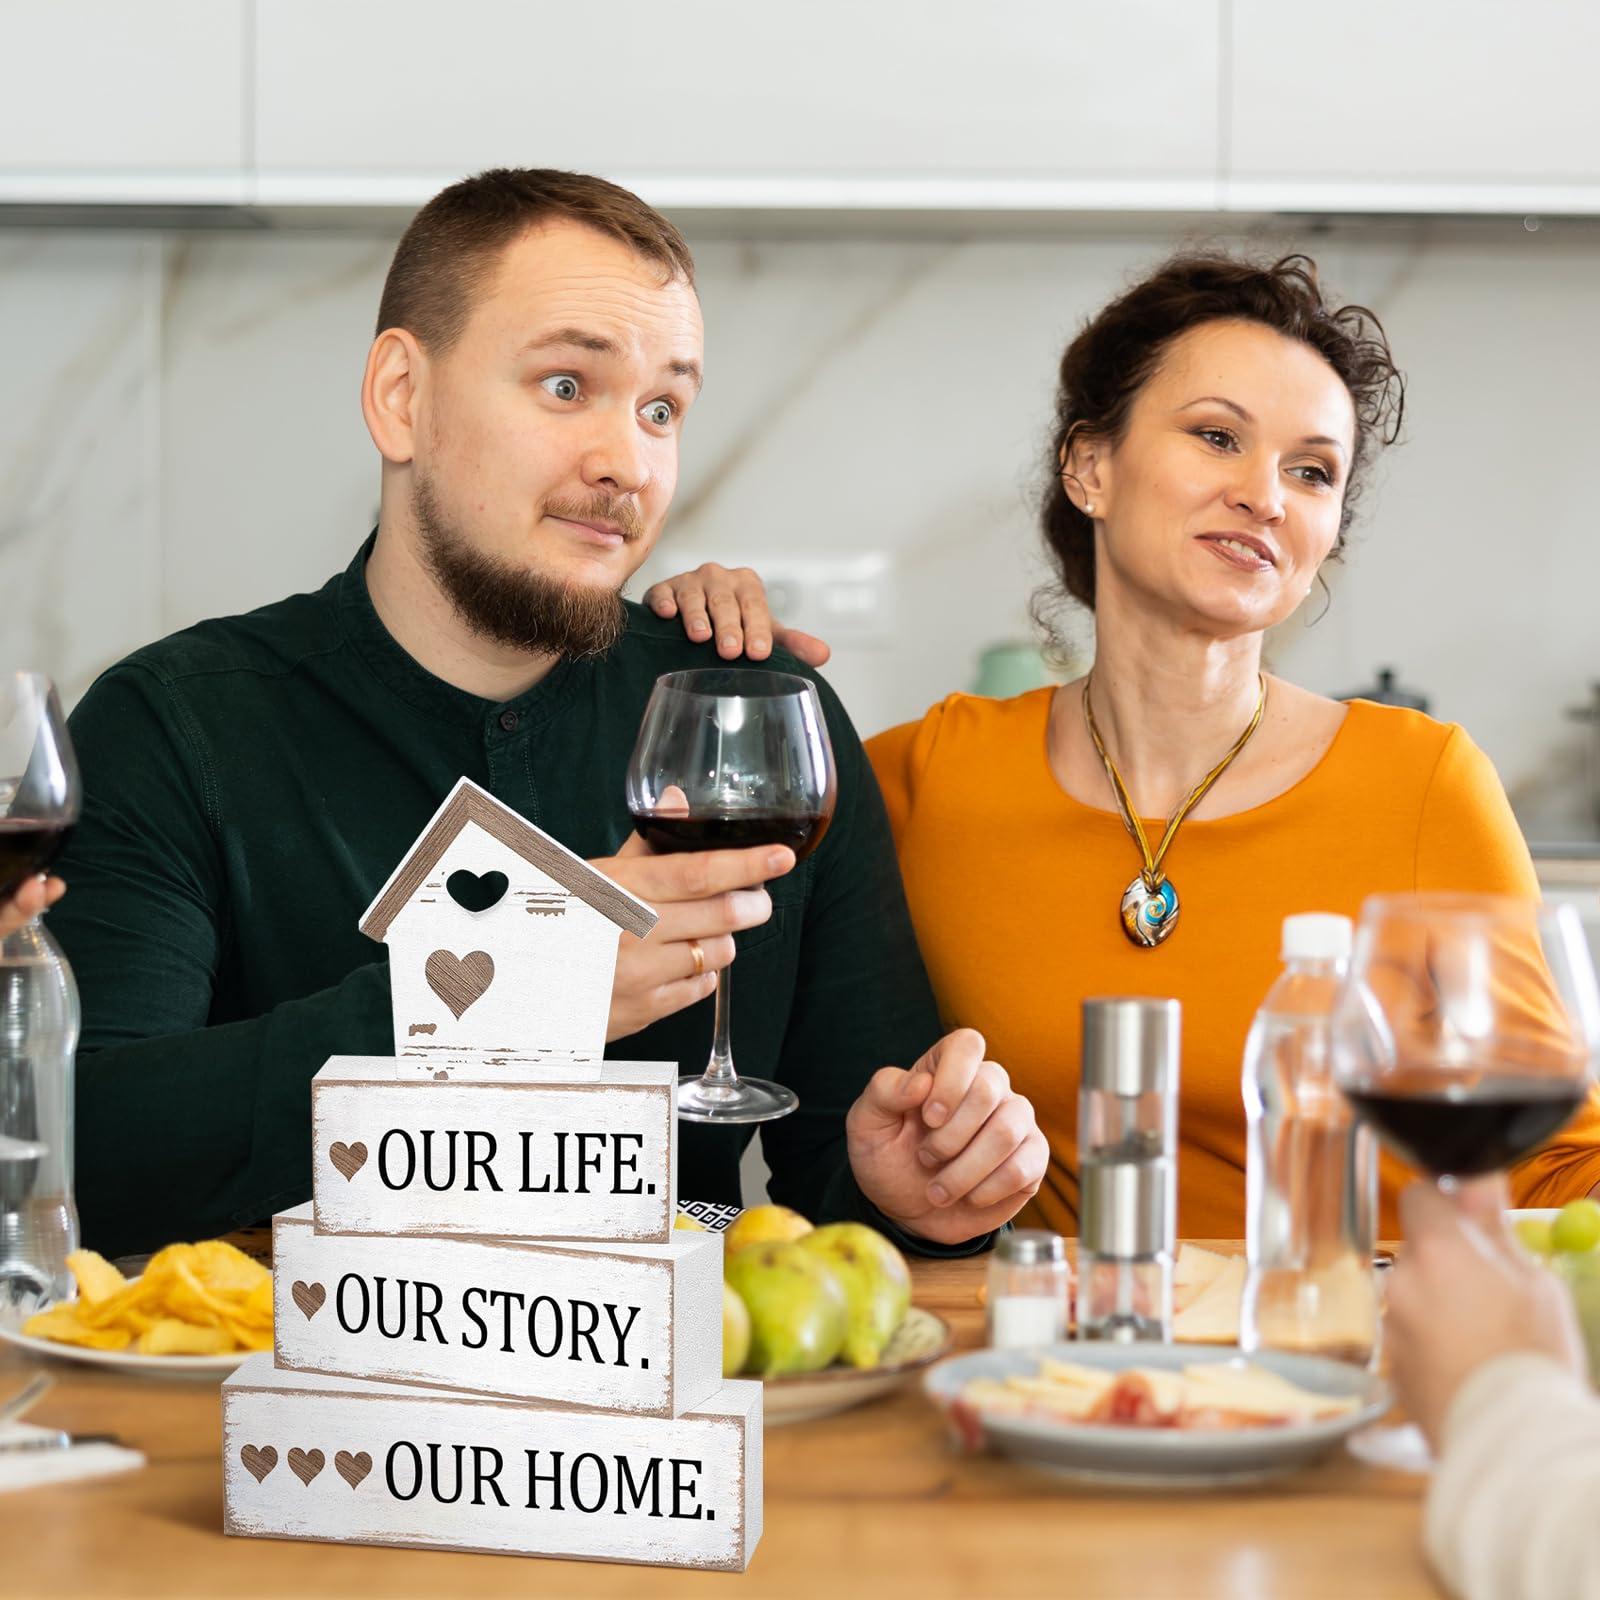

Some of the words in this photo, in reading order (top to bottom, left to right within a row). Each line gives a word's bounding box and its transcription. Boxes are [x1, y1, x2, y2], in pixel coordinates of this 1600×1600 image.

[379, 1129, 503, 1191] OUR
[519, 1132, 655, 1194] LIFE.
[337, 1273, 448, 1344] OUR
[462, 1288, 648, 1369] STORY.
[386, 1441, 509, 1506] OUR
[525, 1450, 714, 1520] HOME.
